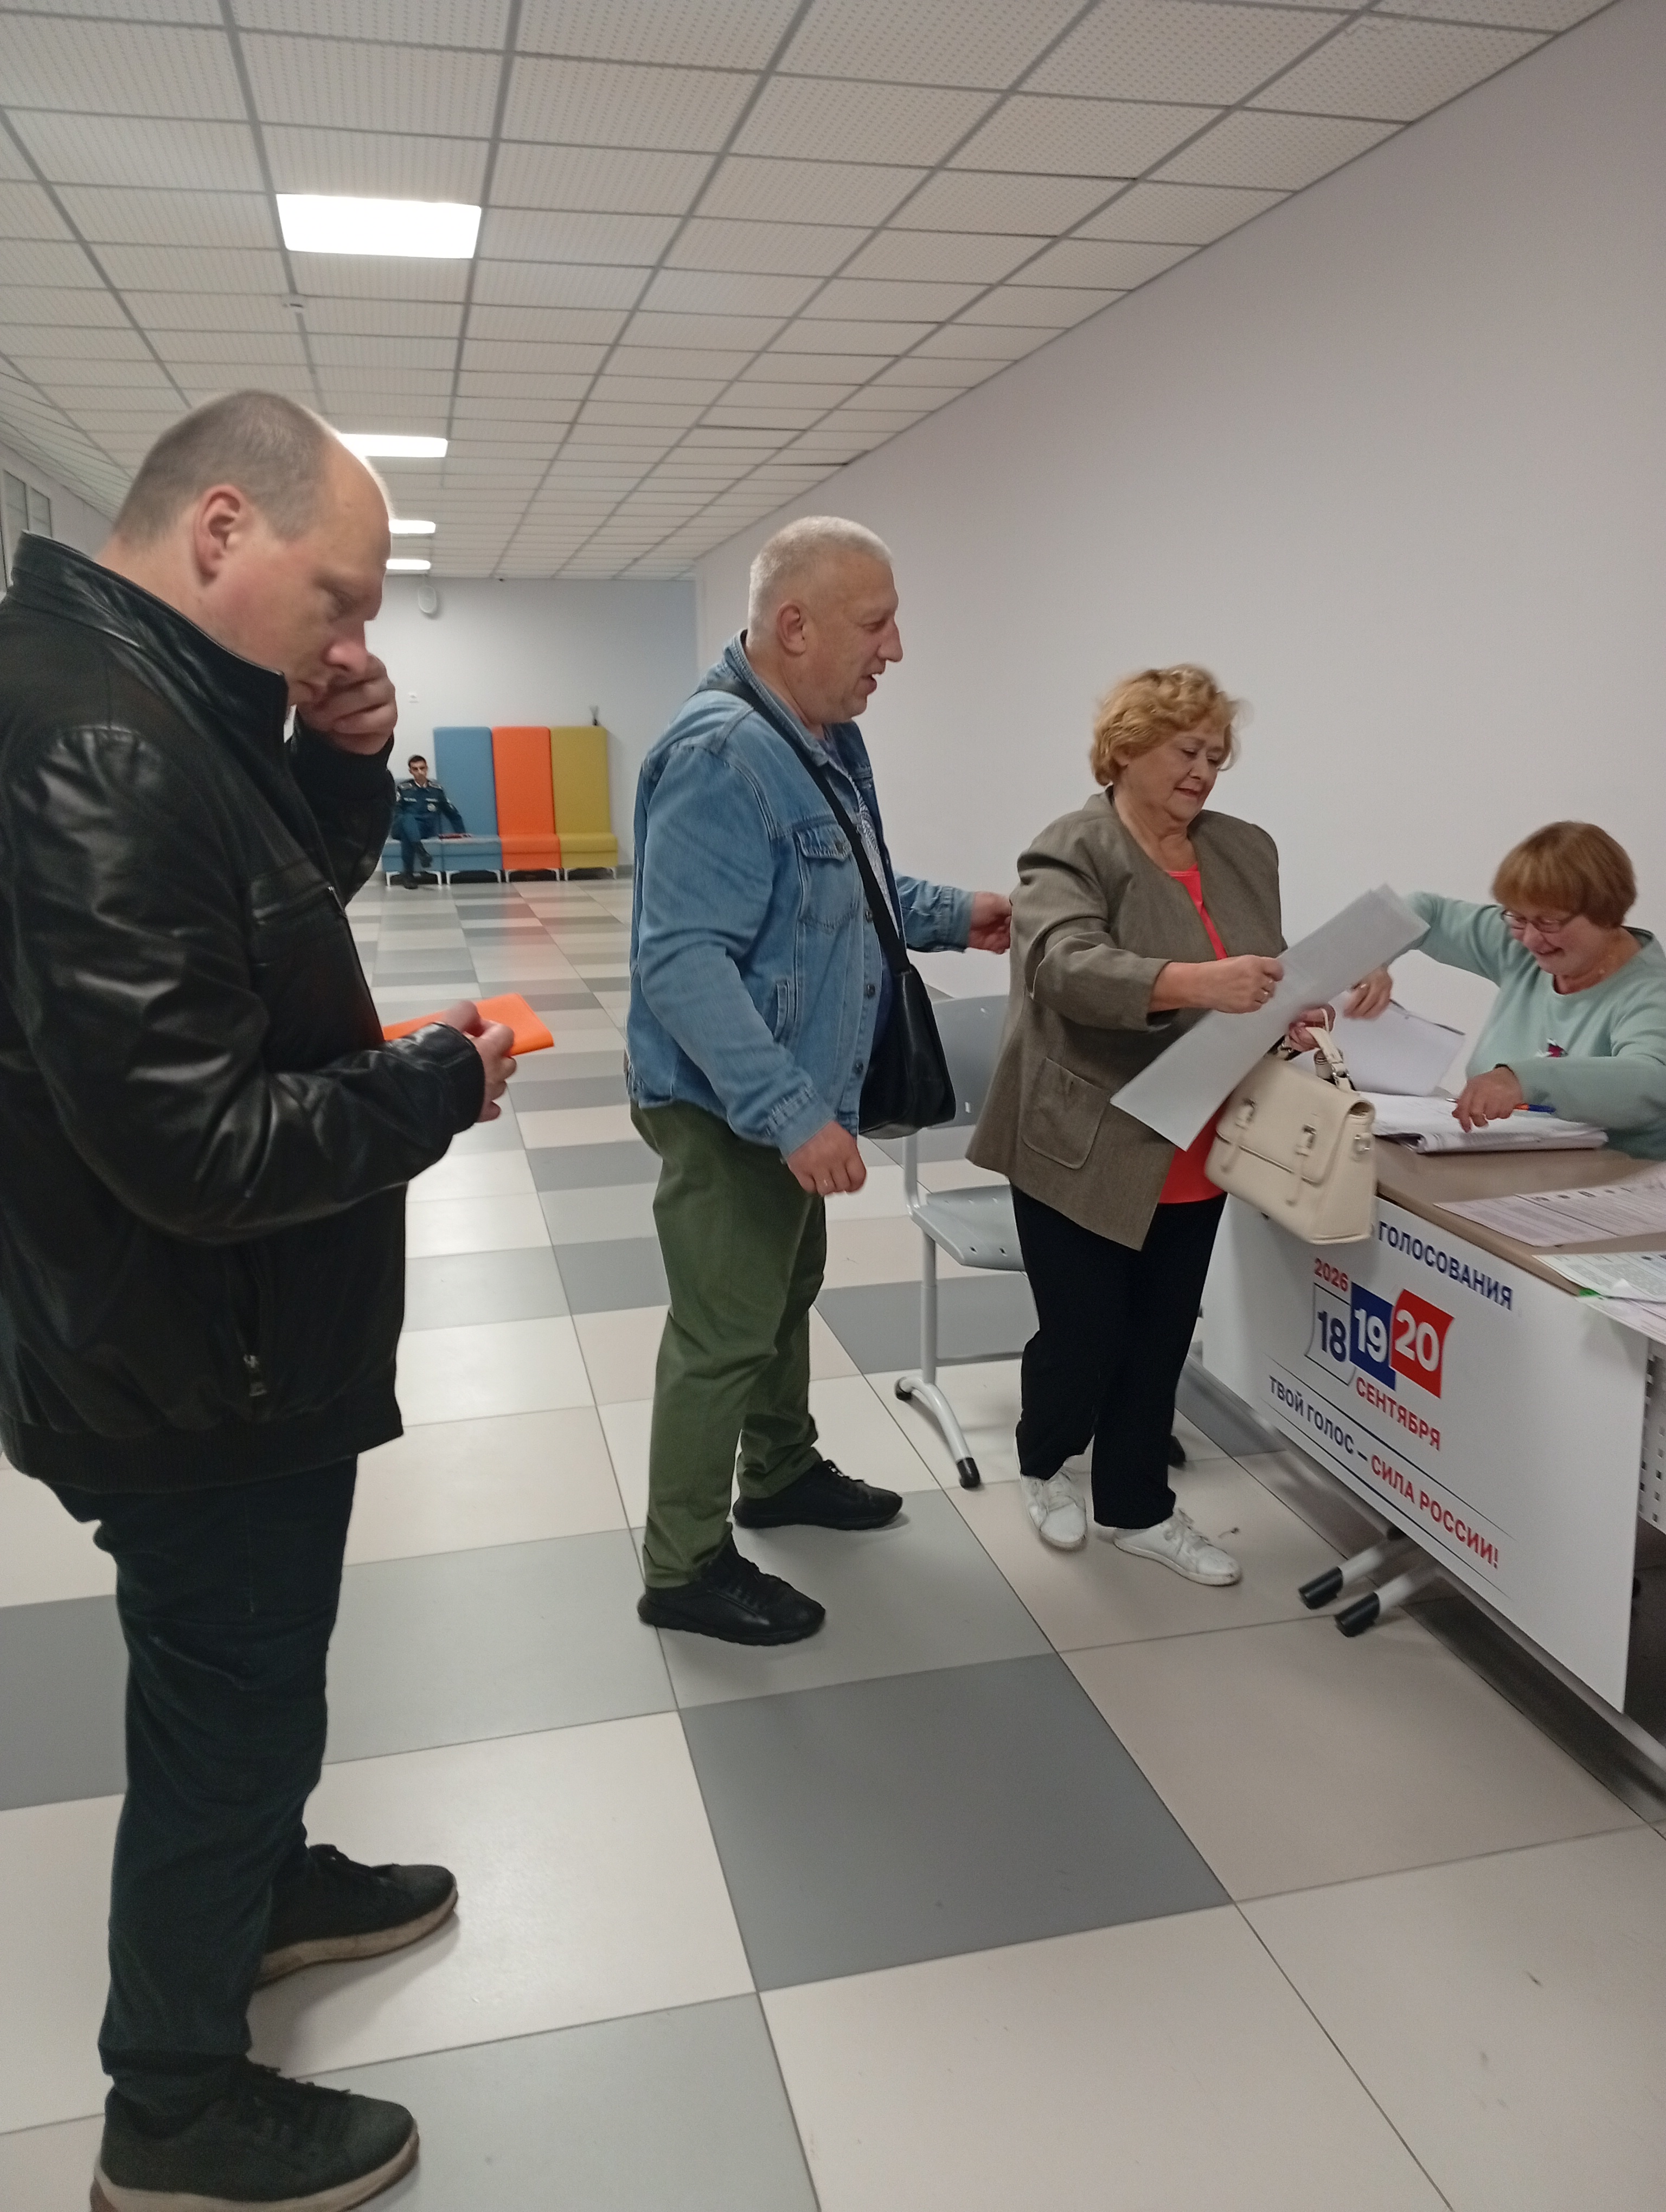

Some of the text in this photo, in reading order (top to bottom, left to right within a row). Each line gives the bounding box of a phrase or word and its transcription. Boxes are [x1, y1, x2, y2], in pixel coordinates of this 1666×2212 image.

[1315, 1257, 1349, 1293] 2026
[1378, 1220, 1513, 1311] ГОЛОСОВАНИЯ
[1317, 1308, 1440, 1372] 18 19 20
[1356, 1377, 1441, 1451] СЕНТЯБРЯ
[1270, 1374, 1304, 1417] ТВОЙ
[1307, 1403, 1355, 1455] ГОЛОС
[1371, 1454, 1415, 1504] СИЛА
[1420, 1489, 1498, 1570] РОССИИ!
